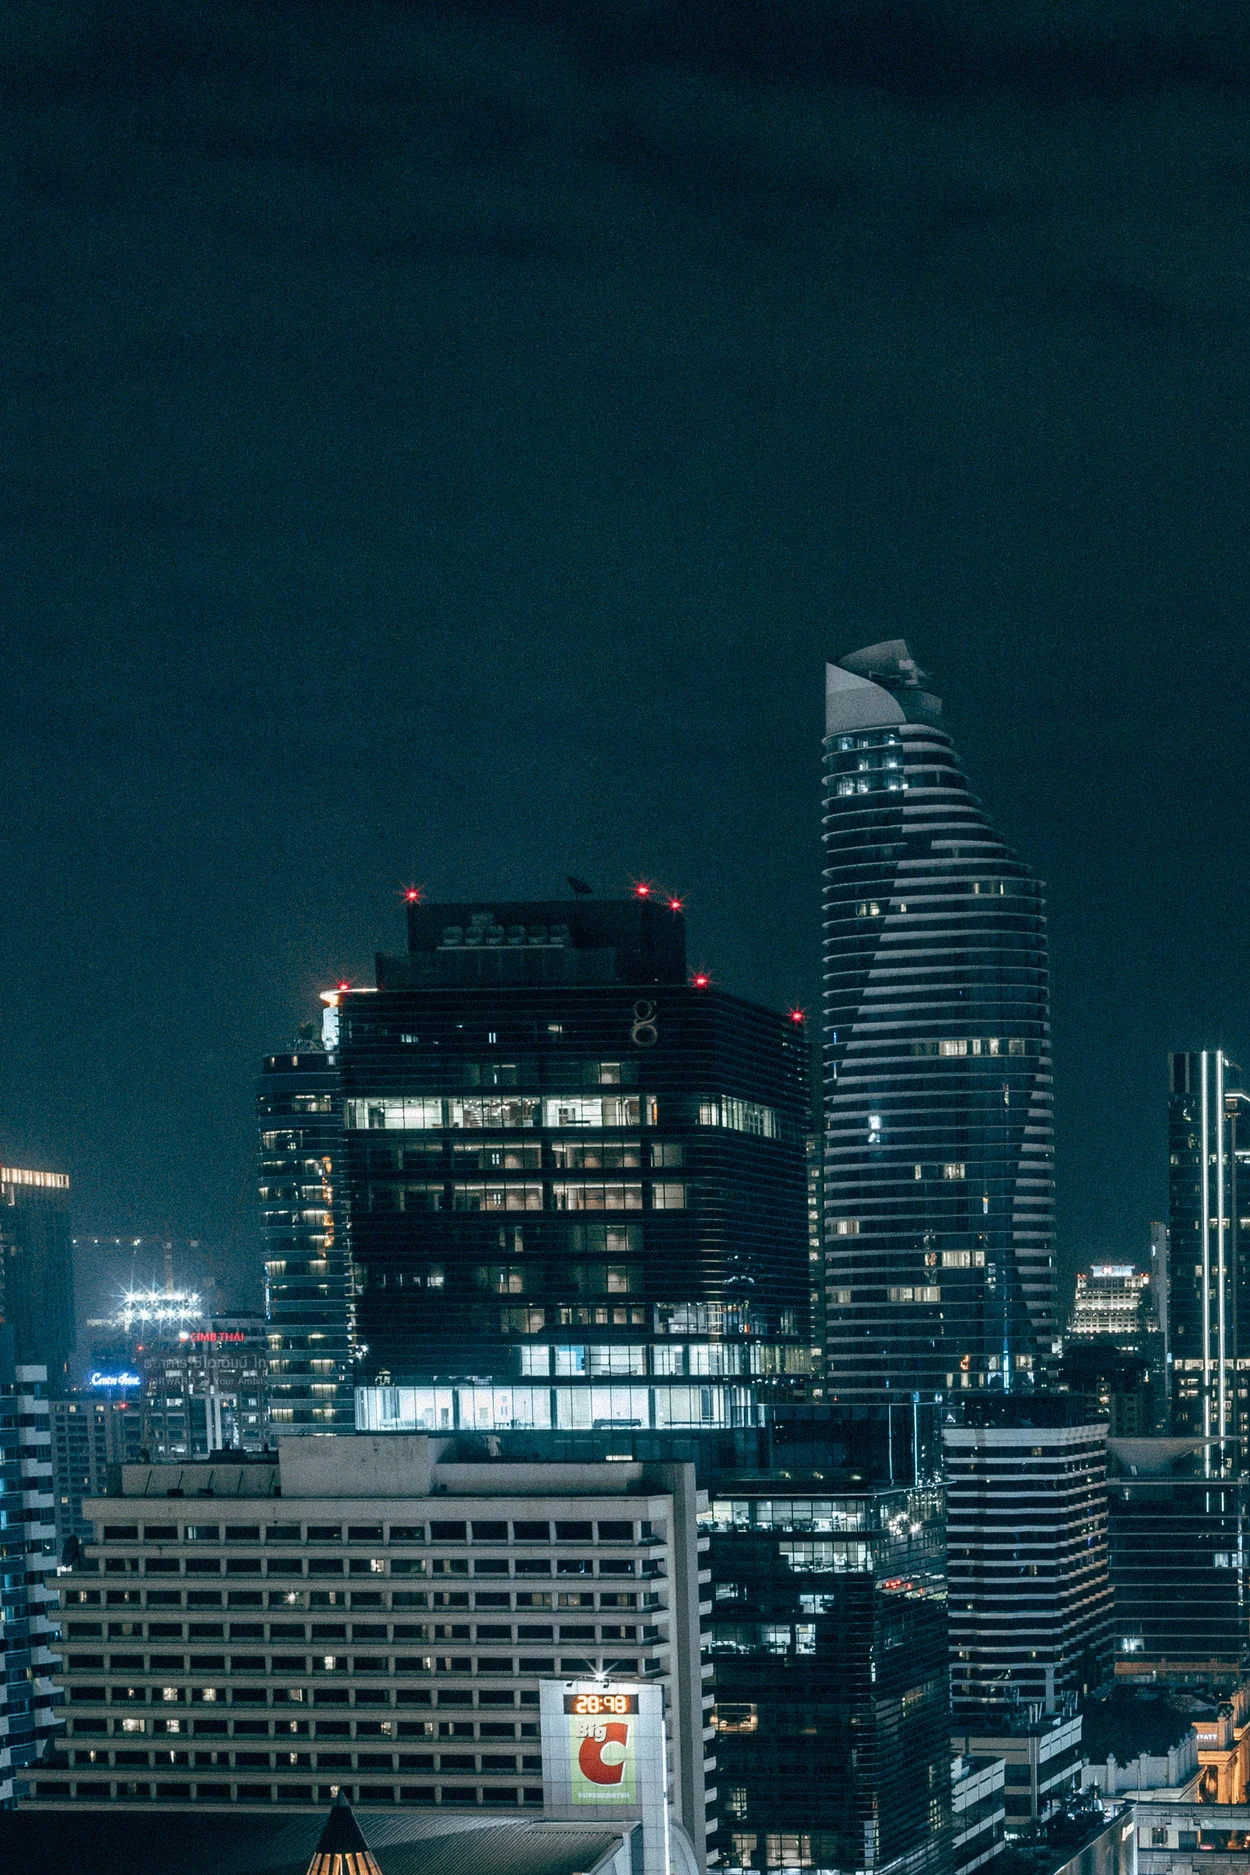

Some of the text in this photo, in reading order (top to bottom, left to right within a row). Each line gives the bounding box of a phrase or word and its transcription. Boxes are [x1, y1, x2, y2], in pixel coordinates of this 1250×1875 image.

[190, 1332, 245, 1342] CIMB THAI
[577, 1722, 607, 1743] Big
